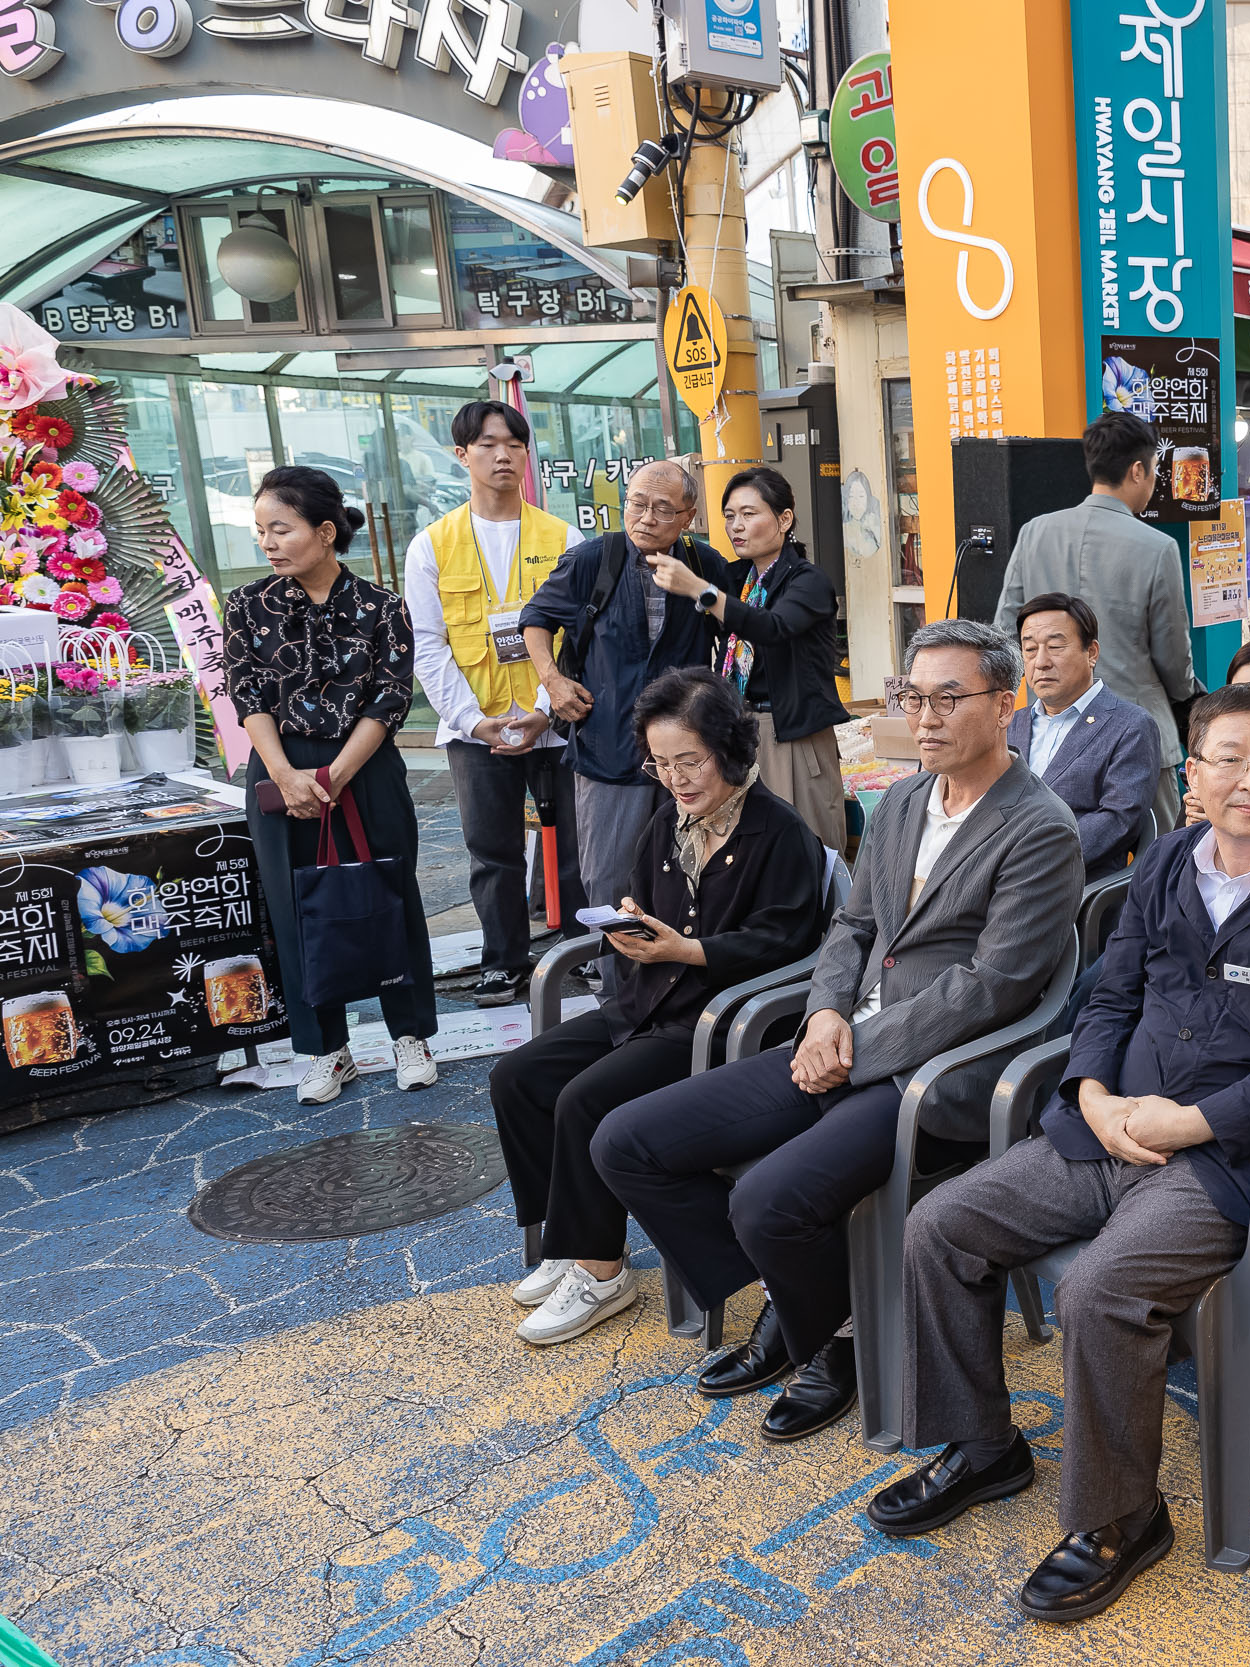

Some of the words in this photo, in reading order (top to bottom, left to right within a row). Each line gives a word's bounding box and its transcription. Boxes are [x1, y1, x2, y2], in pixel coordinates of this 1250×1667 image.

[1094, 96, 1115, 204] HWAYANG
[1099, 208, 1116, 245] JEIL
[1099, 250, 1120, 329] MARKET
[477, 288, 560, 317] 탁구장
[576, 288, 606, 312] B1
[69, 305, 135, 332] 당구장
[149, 305, 179, 327] B1
[686, 346, 706, 362] SOS
[684, 372, 713, 389] 긴급신고
[1132, 378, 1208, 400] 화양연화
[1133, 402, 1207, 424] 맥주축제
[1181, 501, 1198, 512] BEER
[578, 505, 609, 529] B1
[497, 634, 525, 646] 안전요
[216, 861, 228, 871] 제
[229, 858, 248, 870] 5회
[16, 892, 28, 902] 제
[31, 888, 53, 900] 5회
[127, 872, 250, 912] 화양연화
[130, 900, 252, 938] 맥주축제
[180, 937, 205, 948] BEER
[207, 930, 252, 943] FESTIVAL
[7, 965, 59, 979] FESTIVAL
[109, 1022, 165, 1045] 09.24
[227, 1026, 251, 1035] BEER
[110, 1036, 171, 1053] 화양제일골목시장
[29, 1067, 57, 1077] BEER
